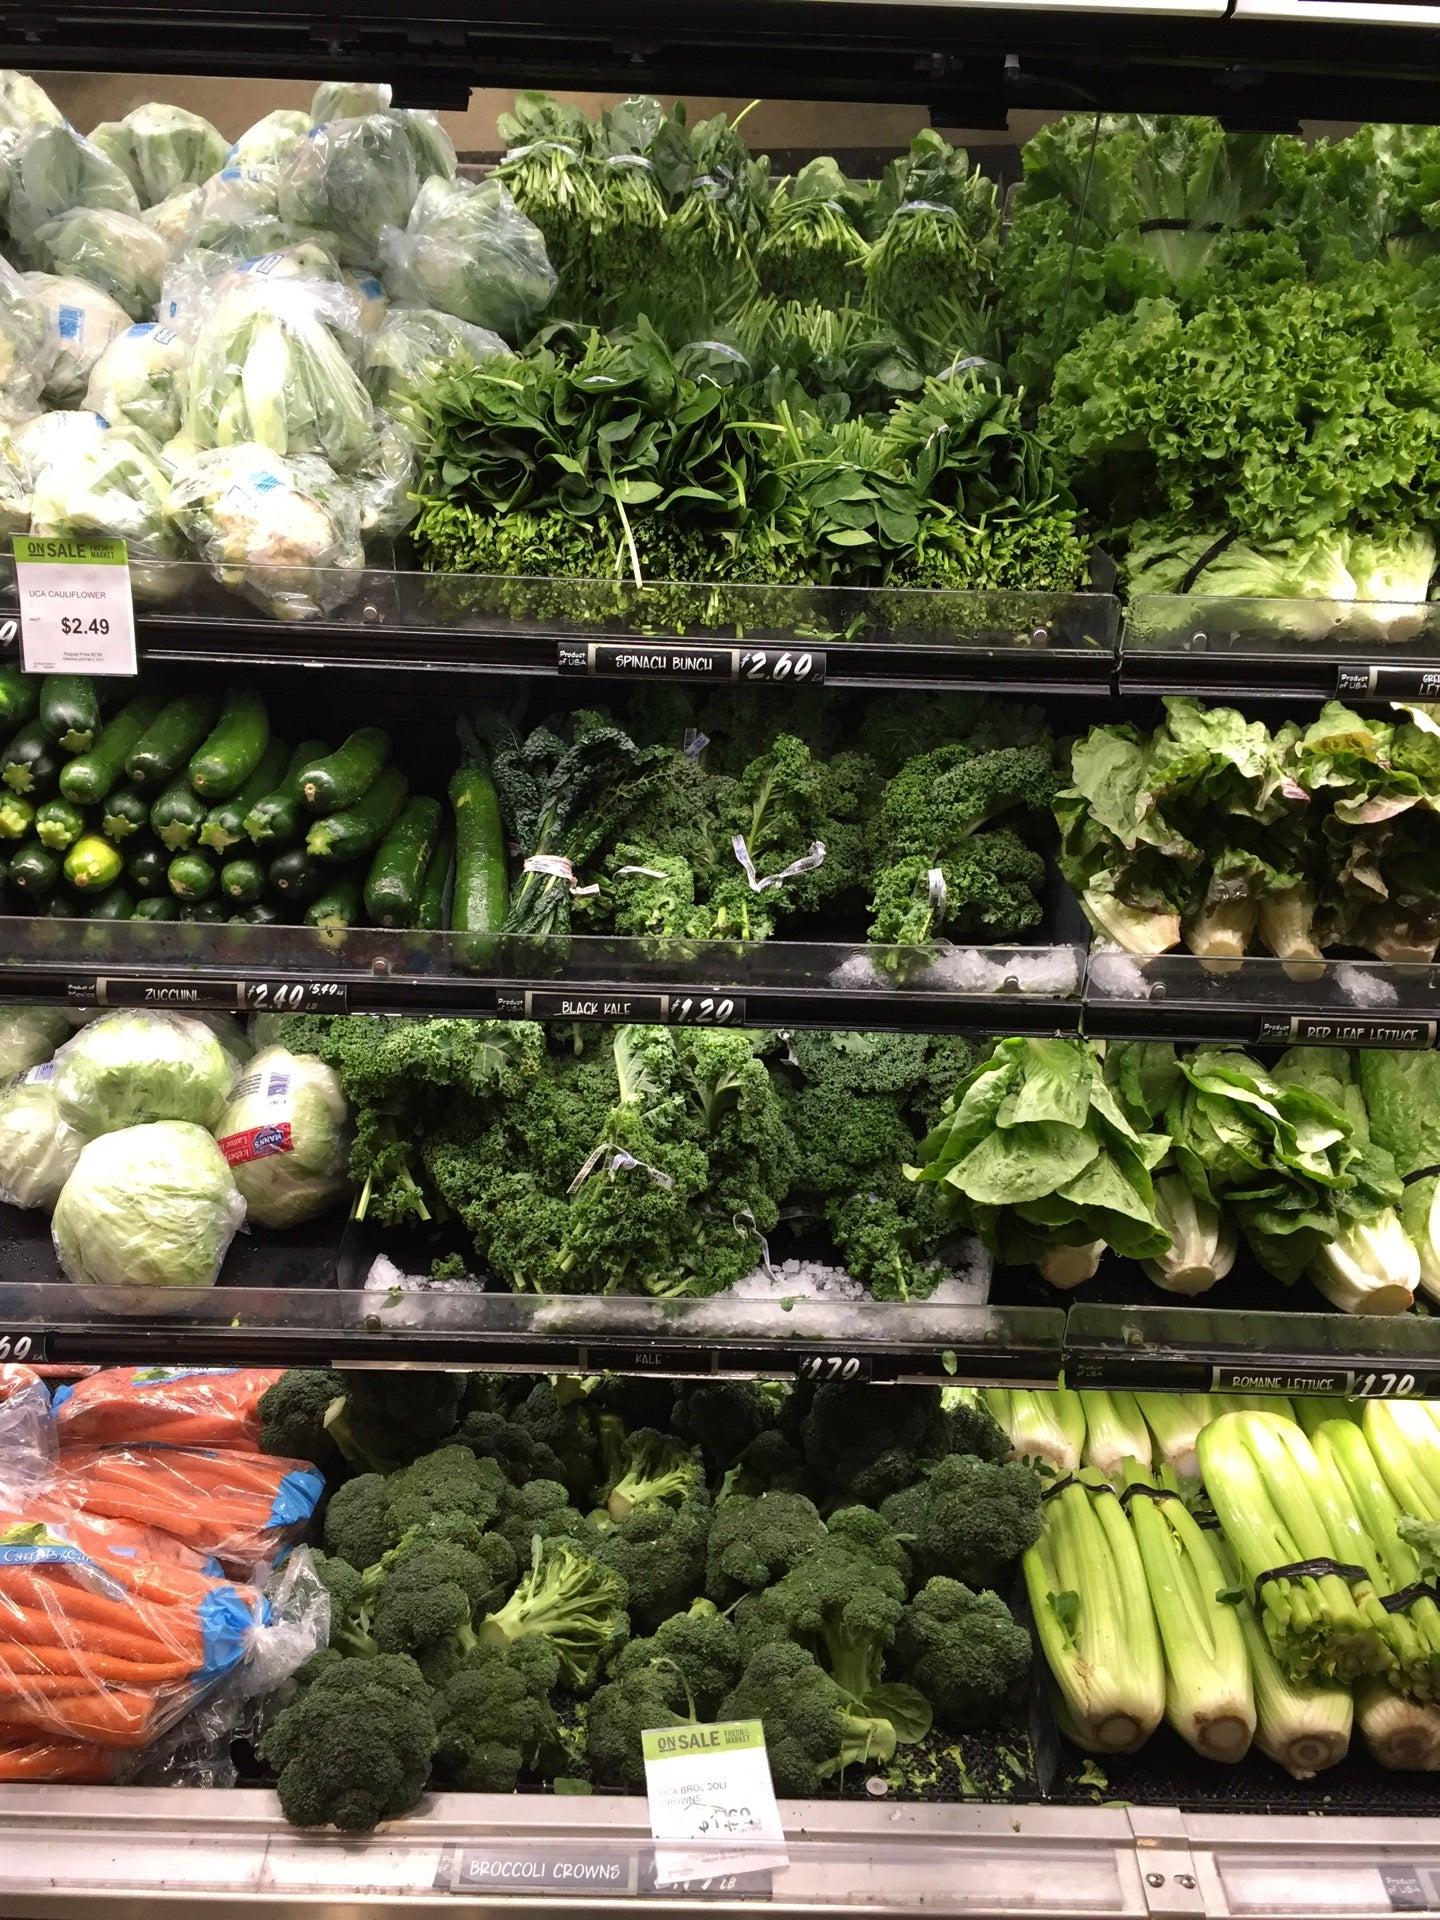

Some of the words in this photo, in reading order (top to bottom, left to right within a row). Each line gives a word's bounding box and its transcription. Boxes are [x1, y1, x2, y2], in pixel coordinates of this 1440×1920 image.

[28, 542, 45, 556] ON
[47, 542, 86, 558] SALE
[29, 590, 46, 598] UCA
[48, 590, 106, 599] CAULIFLOWER
[61, 617, 110, 635] $2.49
[559, 650, 586, 659] Product
[568, 658, 587, 666] USA
[615, 654, 667, 669] SPINACH
[672, 656, 713, 671] BUNCH
[144, 988, 200, 1001] ZUCCHINI
[305, 1002, 318, 1010] LB
[497, 998, 524, 1006] Product
[561, 1001, 598, 1016] BLACK
[603, 1002, 631, 1016] KALE
[1306, 1026, 1331, 1039] RED
[1336, 1027, 1365, 1041] LEAF
[1370, 1028, 1419, 1042] LETTUCE
[635, 1354, 662, 1365] KALE
[1232, 1376, 1282, 1389] ROMAINE
[1287, 1377, 1334, 1390] LETTUCE
[1353, 1373, 1415, 1397] $179
[657, 1736, 676, 1752] ON
[678, 1730, 720, 1749] SALE
[725, 1735, 750, 1744] MARKET
[469, 1860, 545, 1878] BROCCOLI
[552, 1862, 620, 1879] CROWNS
[720, 1877, 736, 1890] LB
[1386, 1877, 1416, 1885] Product
